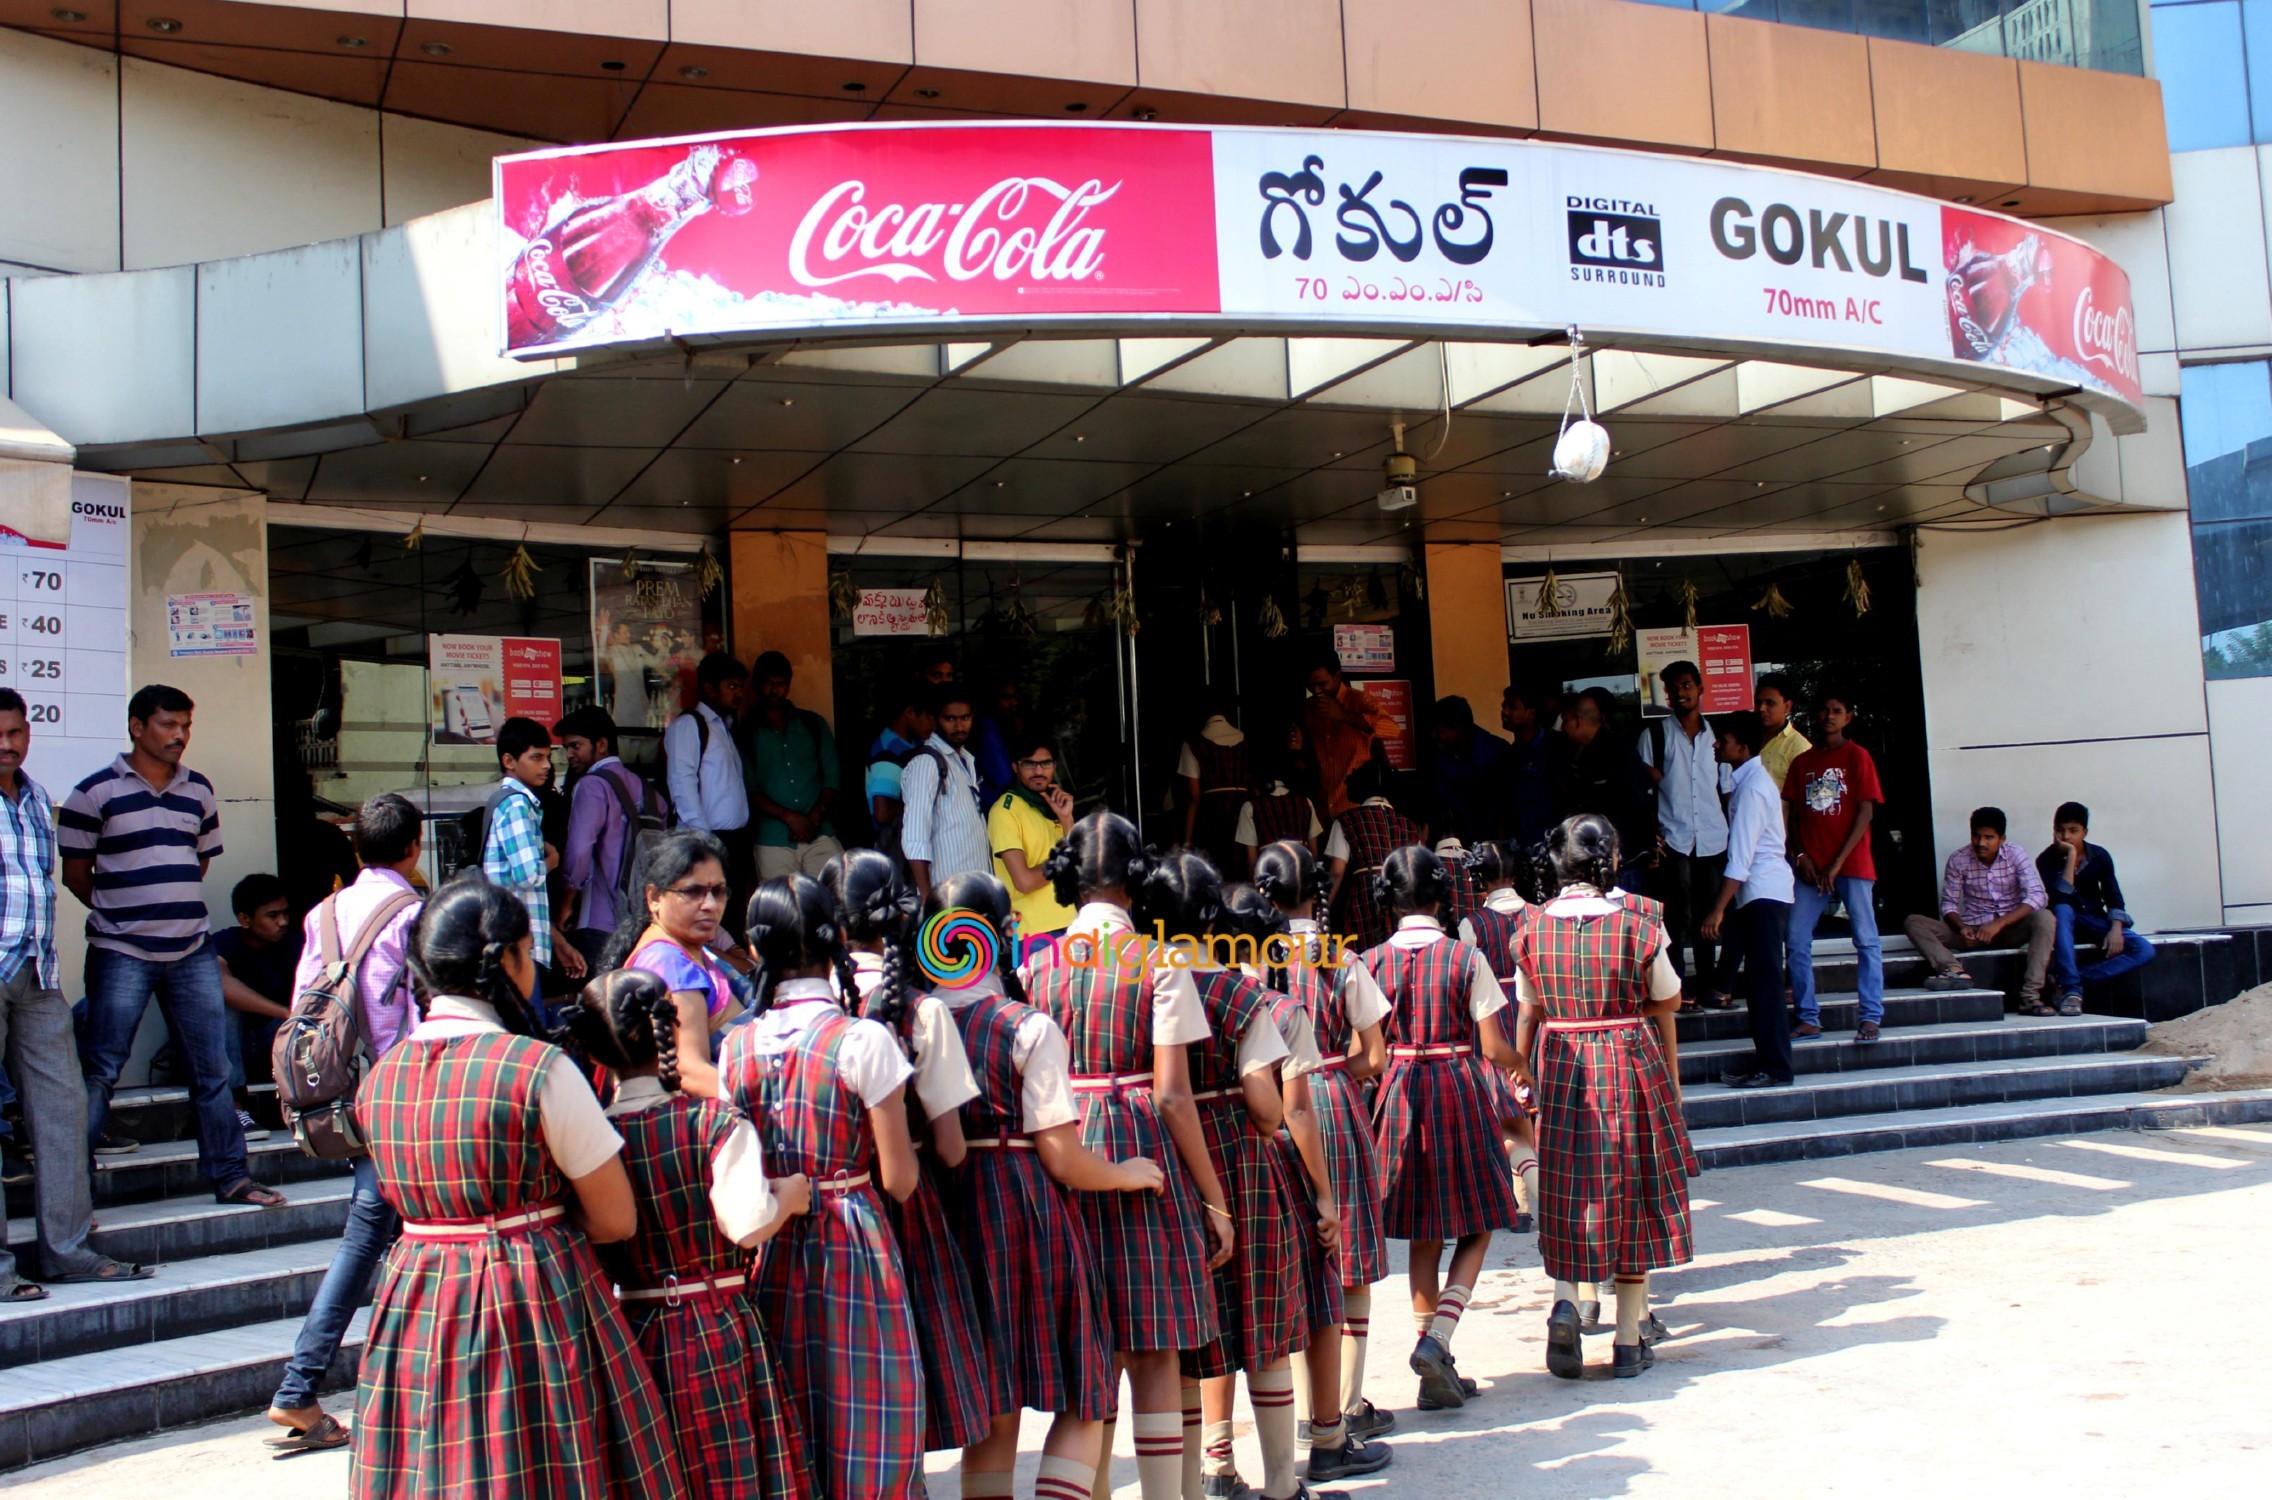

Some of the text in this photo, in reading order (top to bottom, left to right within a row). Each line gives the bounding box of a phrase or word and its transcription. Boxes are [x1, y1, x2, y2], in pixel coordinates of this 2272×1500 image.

[1259, 154, 1509, 266] గోకుల్
[1566, 195, 1660, 216] DIGITAL
[788, 177, 1123, 288] Coca-Cola
[1577, 220, 1655, 263] dts
[1710, 196, 1928, 284] GOKUL
[1571, 267, 1665, 288] SURROUND
[1295, 277, 1328, 300] 70
[1763, 288, 1883, 325] 70mm A/C
[72, 501, 126, 519] GOKUL
[636, 580, 680, 597] PREM
[625, 594, 659, 607] RATAN
[1522, 612, 1536, 620] No
[1587, 607, 1612, 616] Area
[466, 652, 490, 660] TICKETS
